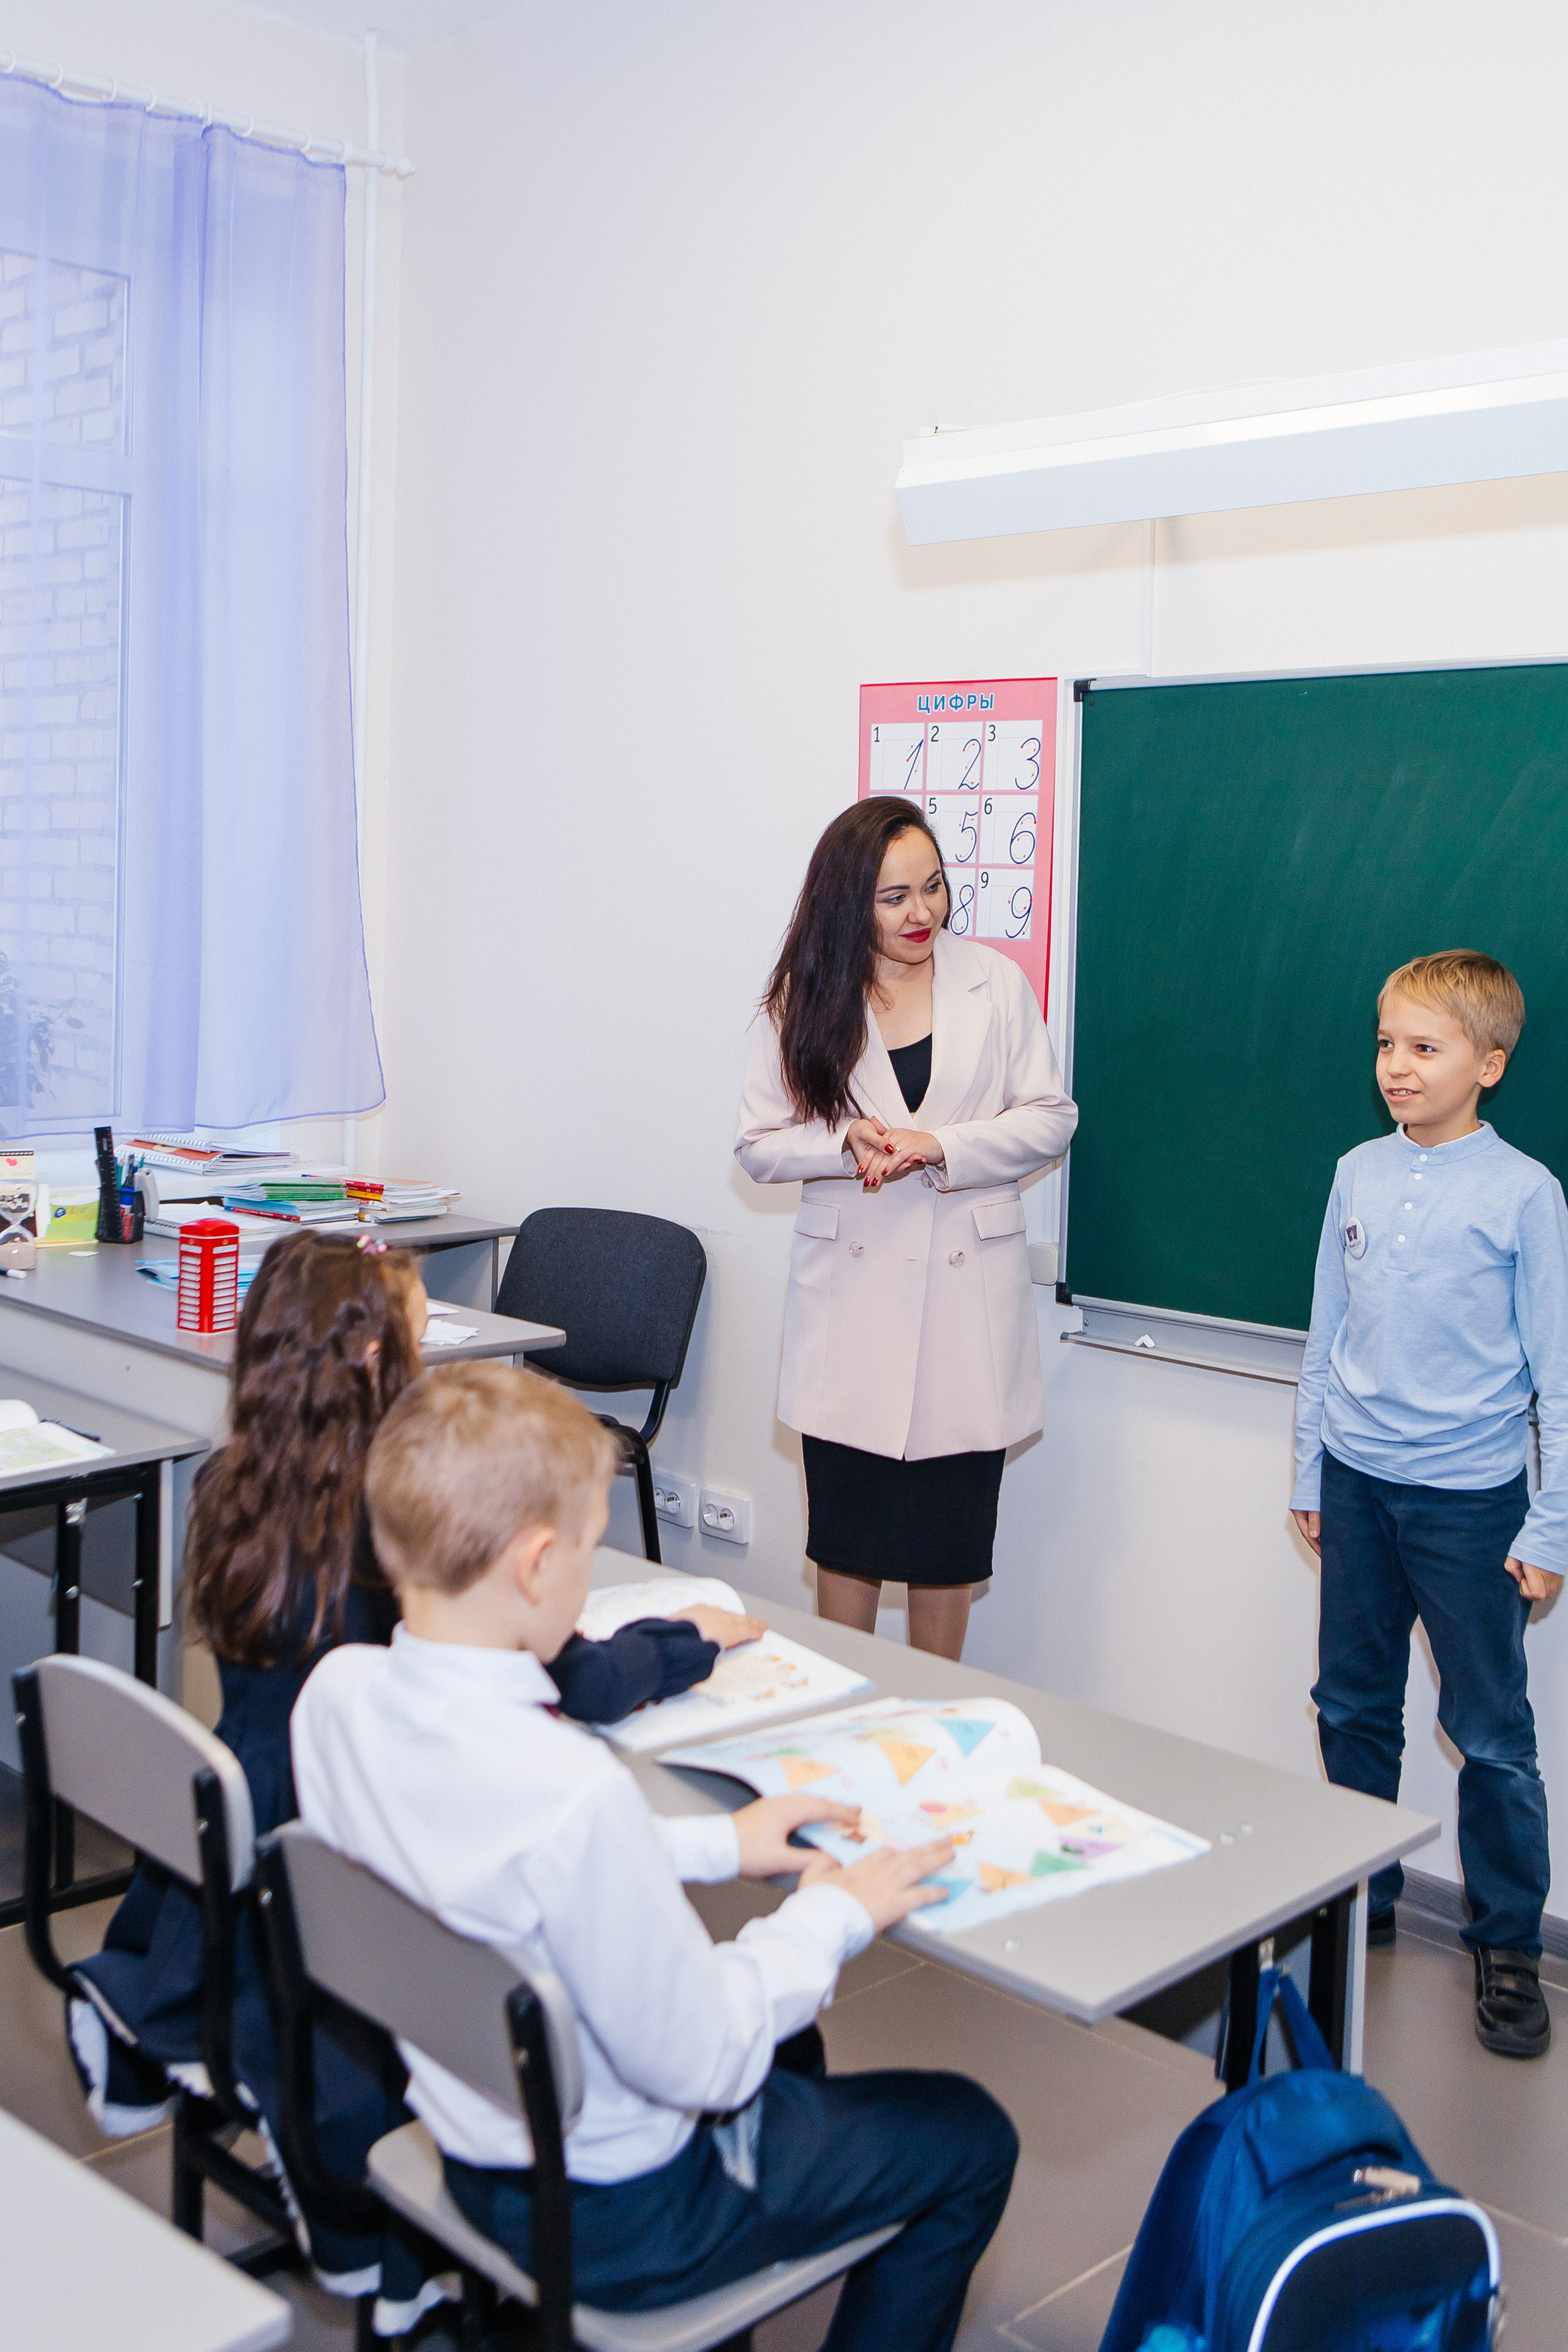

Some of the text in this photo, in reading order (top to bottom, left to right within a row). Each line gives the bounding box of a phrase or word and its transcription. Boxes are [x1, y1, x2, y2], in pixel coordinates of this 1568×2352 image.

[918, 693, 994, 714] ЦИФРЫ
[873, 726, 880, 742] 1
[930, 725, 940, 742] 2
[987, 724, 996, 742] 3
[904, 739, 924, 790] 1
[958, 739, 982, 790] 2
[1015, 737, 1041, 790] 3
[928, 797, 938, 814] 5
[984, 797, 993, 815] 6
[955, 811, 978, 863] 5
[1009, 812, 1037, 865] 6
[980, 871, 989, 889] 9
[950, 884, 974, 935] 8
[1005, 886, 1033, 938] 9
